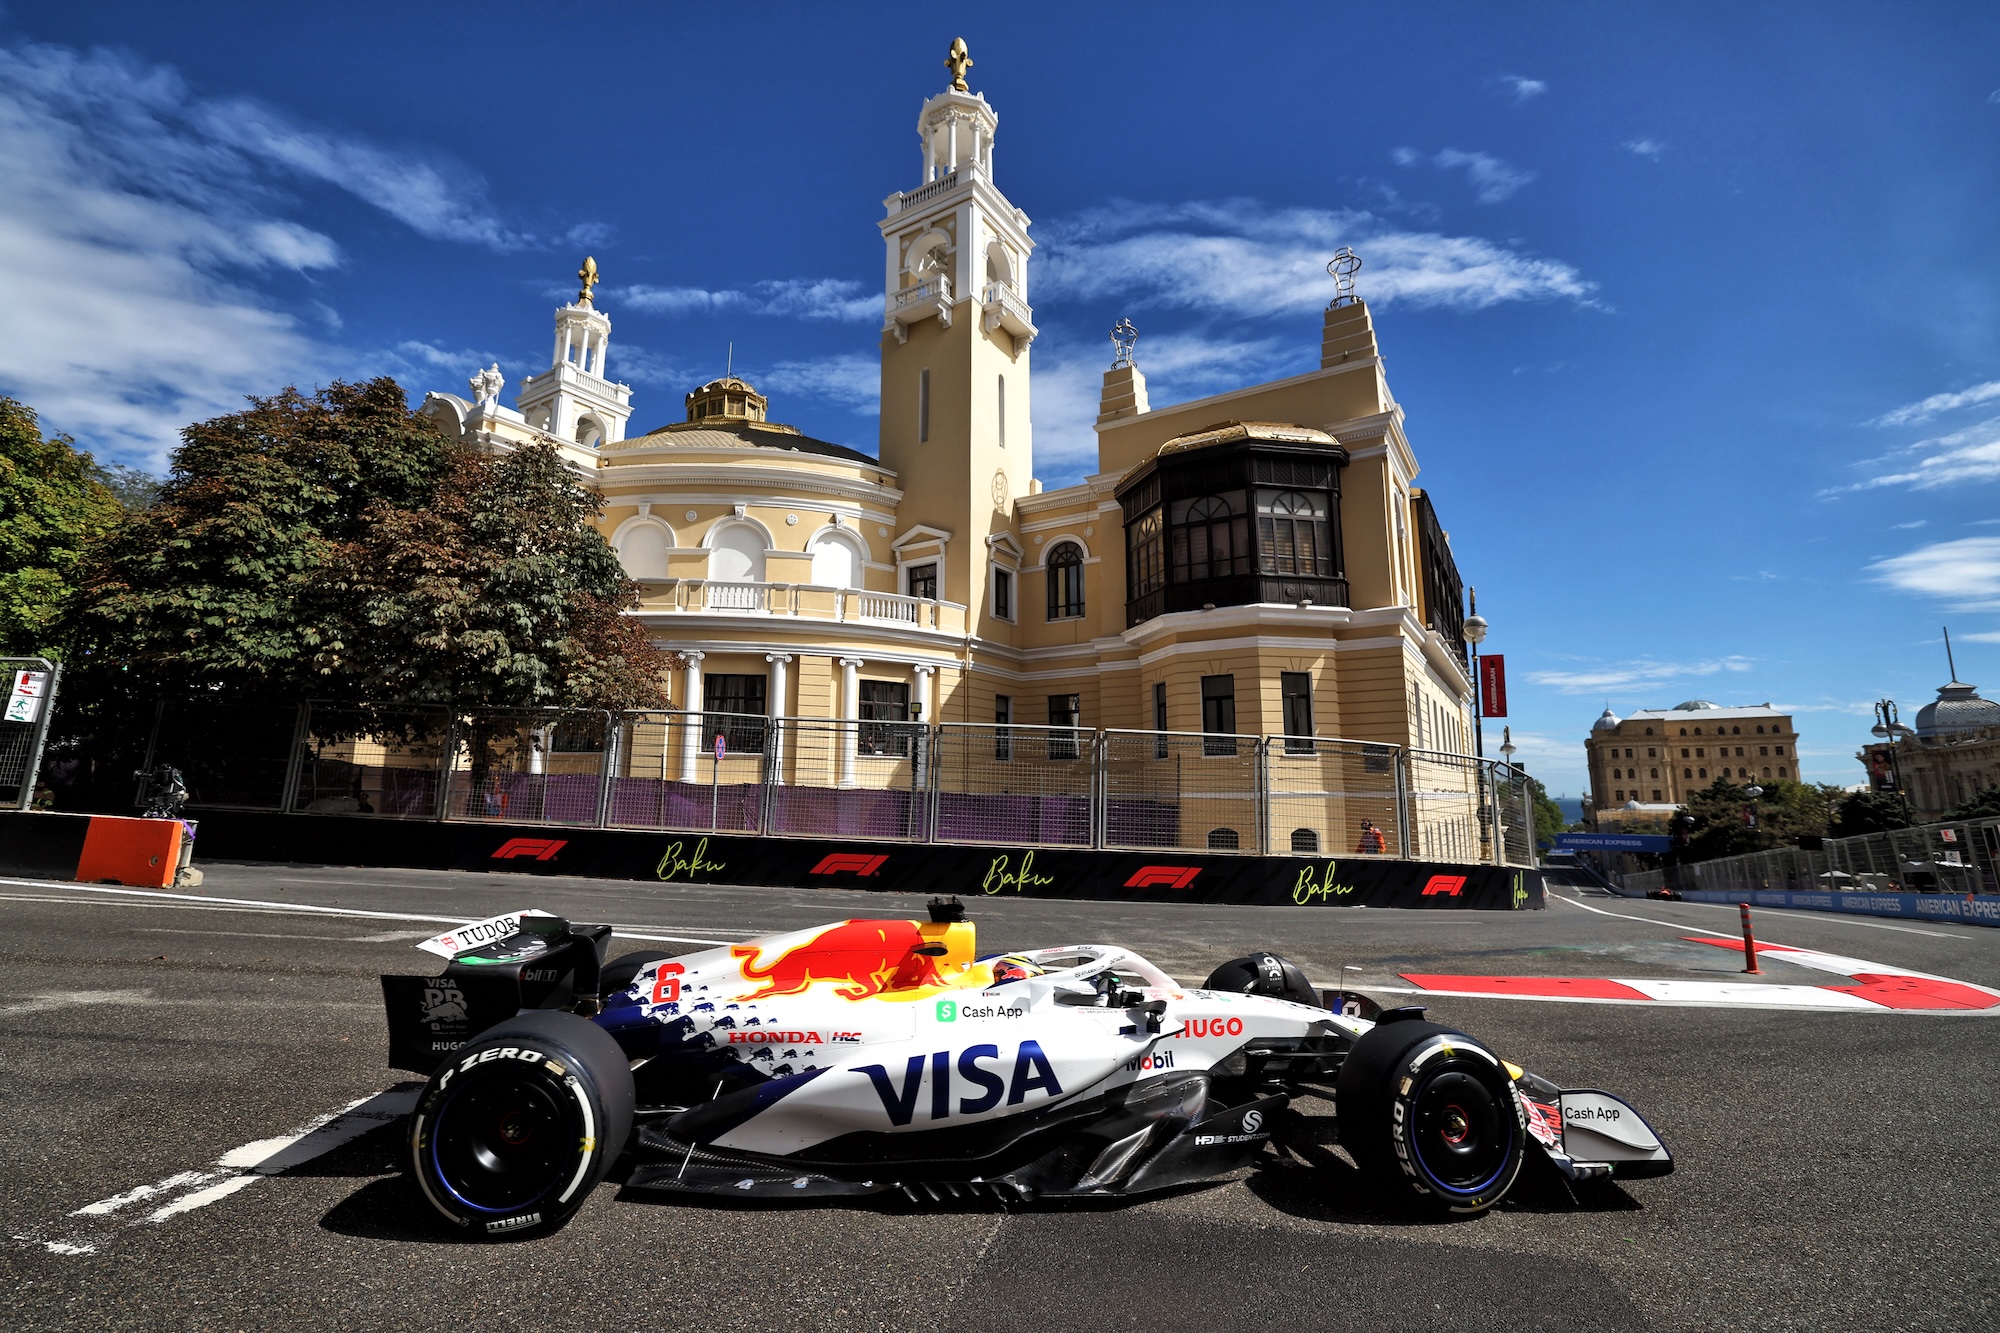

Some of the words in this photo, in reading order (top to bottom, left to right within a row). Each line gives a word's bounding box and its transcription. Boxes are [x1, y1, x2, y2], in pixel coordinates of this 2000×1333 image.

[1604, 839, 1642, 847] EXPRESS
[656, 836, 727, 880] Baku
[982, 850, 1054, 895] Baku
[1292, 860, 1354, 905] Baku
[1841, 896, 1870, 910] AMERICAN
[1870, 897, 1901, 912] EXPRESS
[1916, 898, 1961, 915] AMERICAN
[457, 917, 520, 945] TUDOR
[424, 978, 457, 988] VISA
[652, 963, 685, 1004] 6
[962, 1006, 993, 1018] Cash
[997, 1005, 1023, 1019] App
[728, 1031, 823, 1044] HONDA
[832, 1031, 862, 1042] HRC
[1175, 1017, 1243, 1038] HUGO
[440, 1068, 454, 1091] P
[460, 1047, 543, 1073] ZERO
[1126, 1050, 1175, 1071] Mobil
[847, 1039, 1064, 1127] VISA
[1564, 1107, 1594, 1120] Cash
[1596, 1107, 1620, 1122] App
[1393, 1101, 1416, 1177] ZERO
[1412, 1182, 1431, 1194] P
[486, 1212, 542, 1233] PIRELLI
